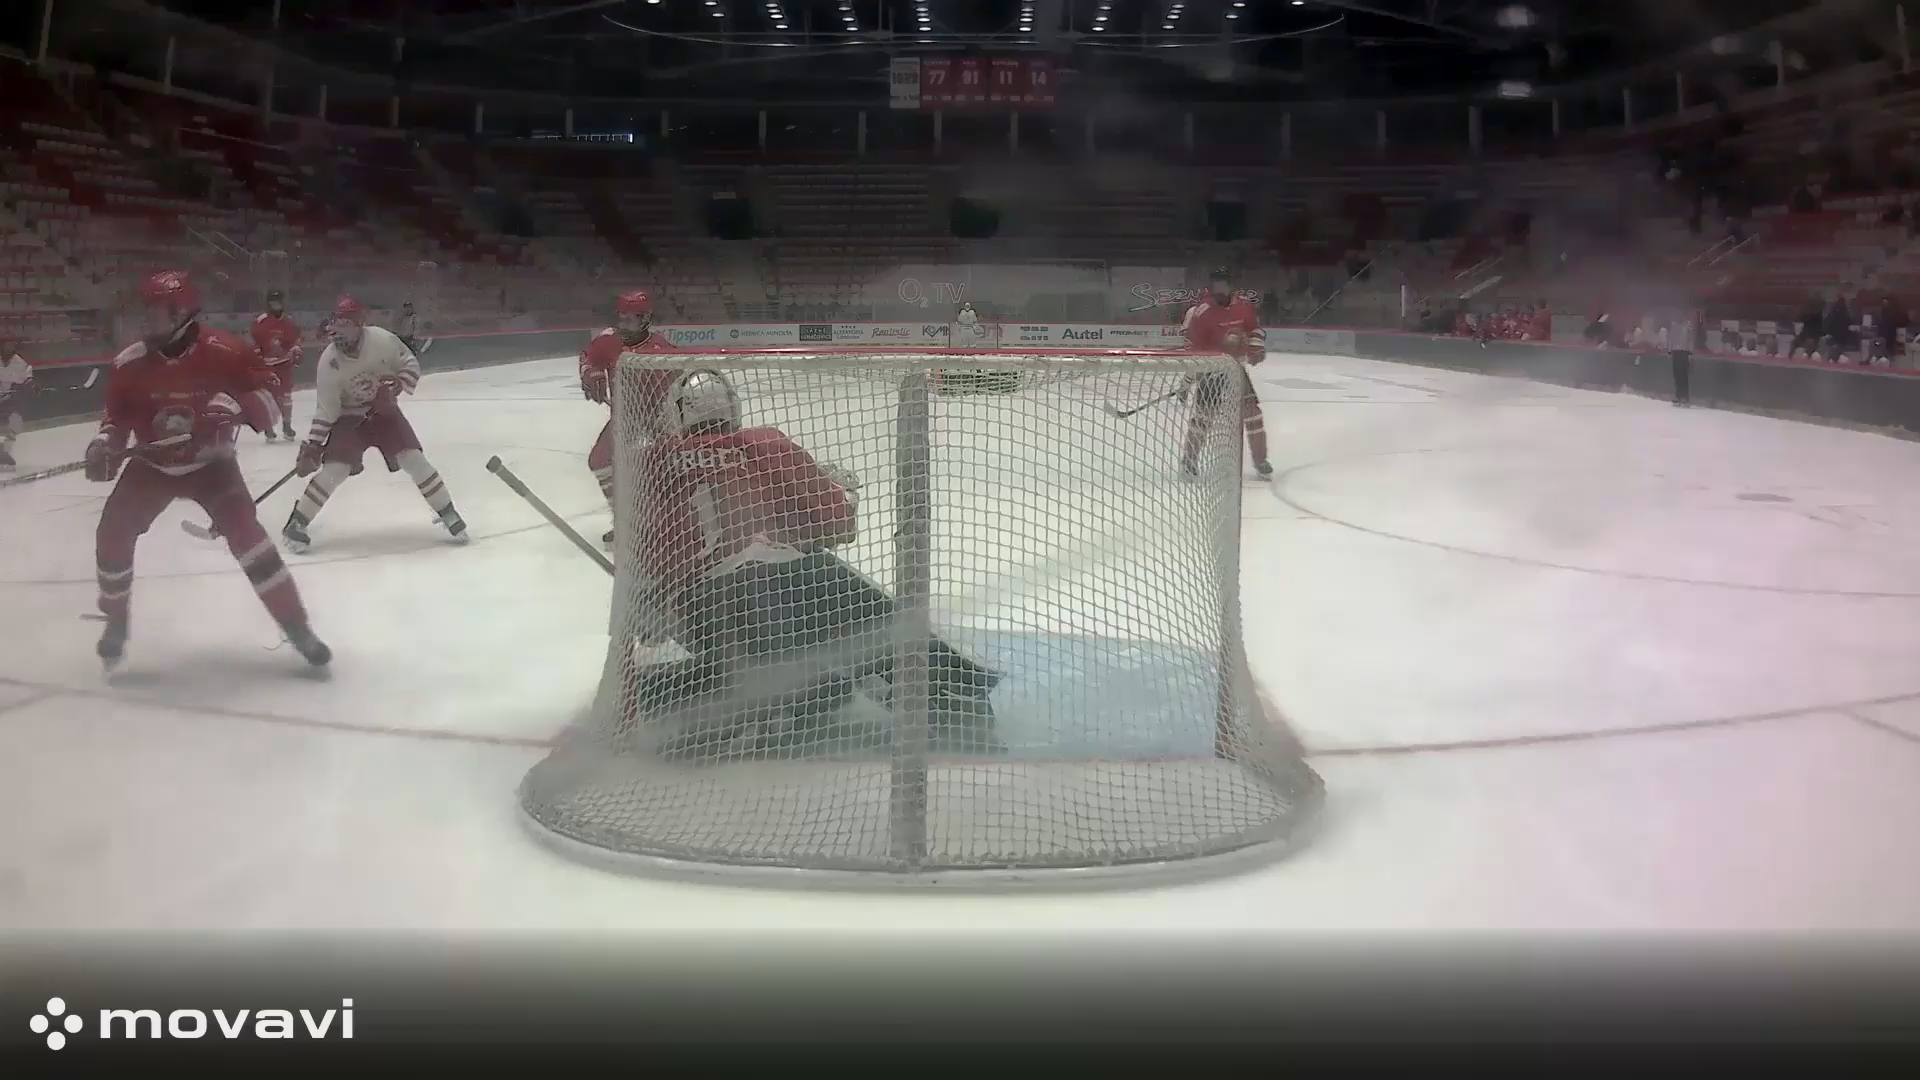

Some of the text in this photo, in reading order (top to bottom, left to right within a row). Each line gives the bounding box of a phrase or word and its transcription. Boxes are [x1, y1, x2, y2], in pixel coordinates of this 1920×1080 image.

[929, 70, 947, 85] 77
[999, 70, 1013, 85] 11
[932, 283, 966, 304] TV
[668, 328, 716, 343] Tipsport
[1062, 328, 1103, 340] Autel
